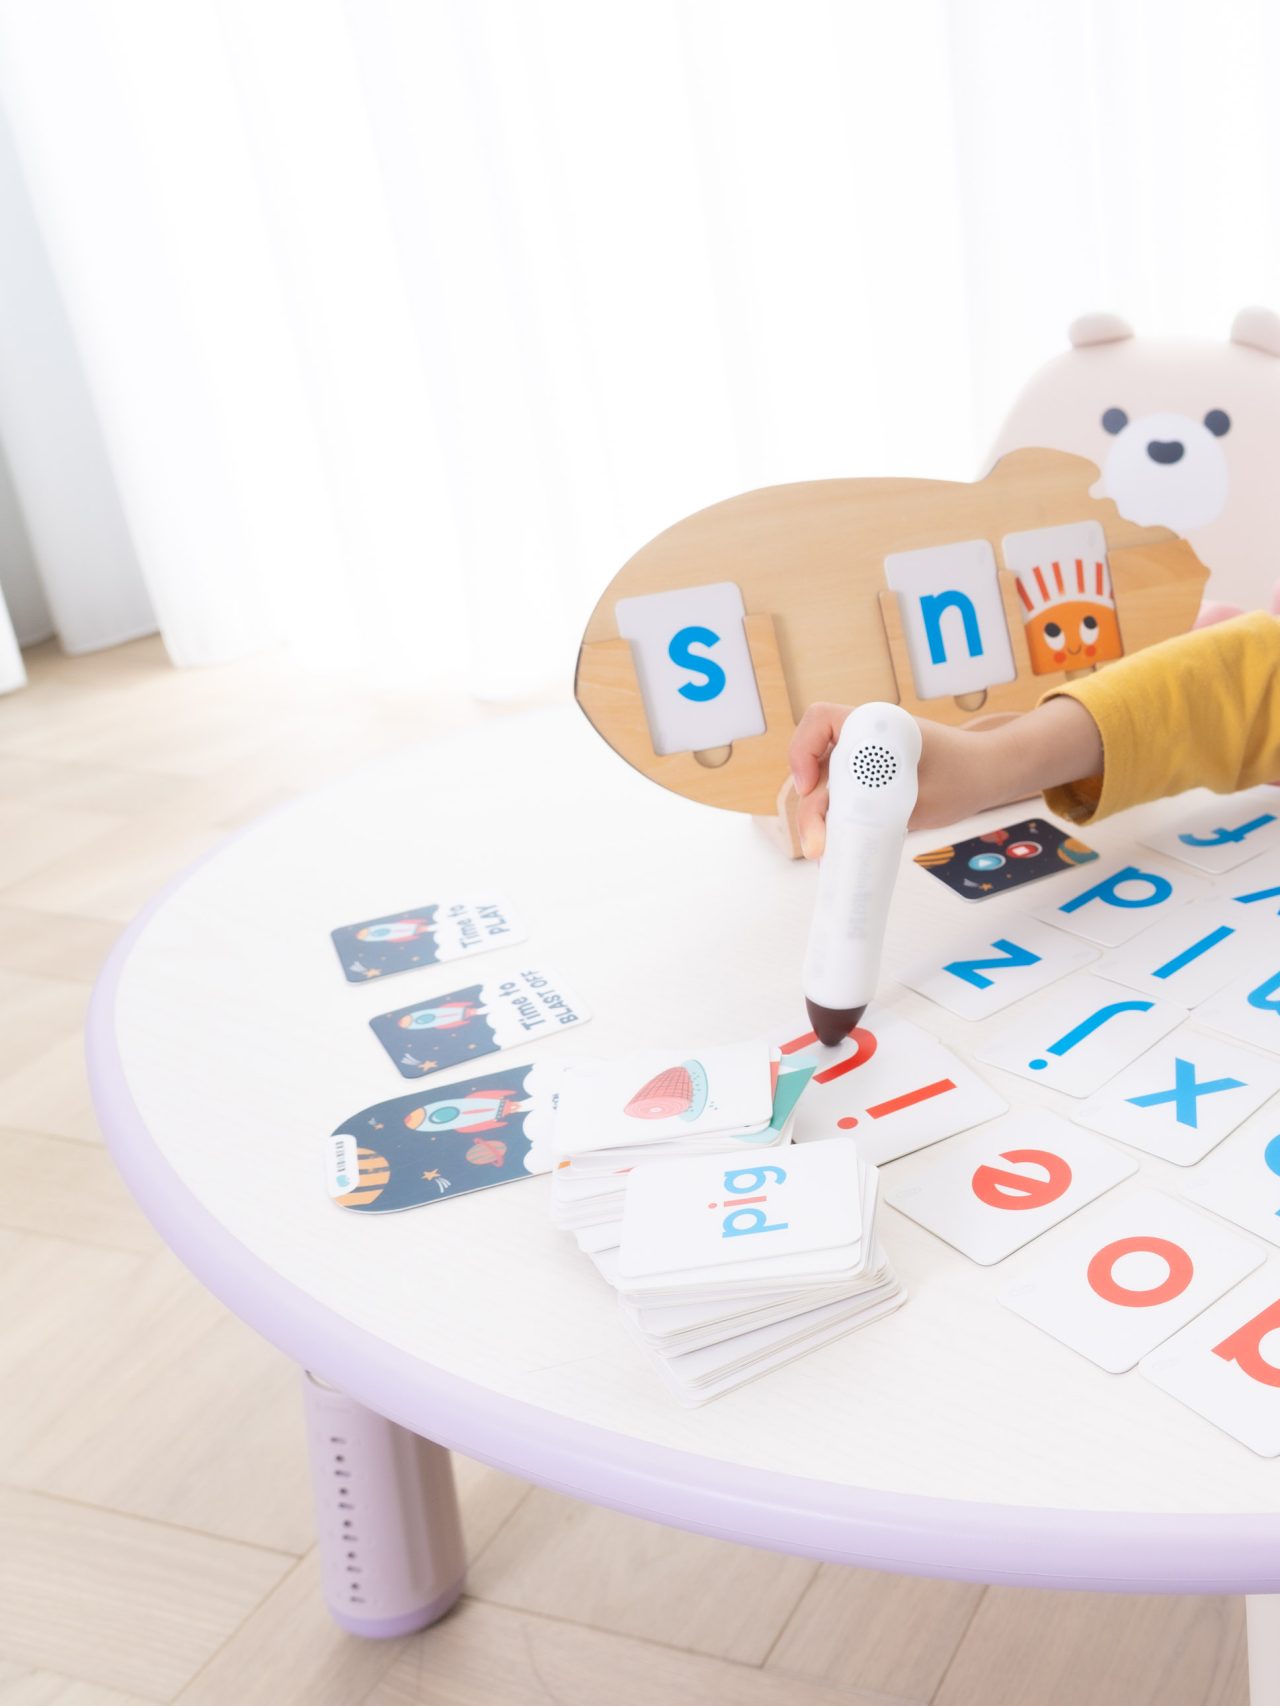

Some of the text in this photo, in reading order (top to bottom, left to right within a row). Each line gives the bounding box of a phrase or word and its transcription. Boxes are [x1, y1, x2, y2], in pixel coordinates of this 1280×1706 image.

[919, 589, 984, 666] n
[667, 625, 727, 703] s
[1179, 814, 1277, 847] f
[448, 904, 483, 948] Time to
[476, 905, 510, 935] PLAY
[943, 938, 1042, 990] z
[499, 982, 546, 1030] Time to
[520, 970, 579, 1025] BLAST OFF
[1028, 1000, 1154, 1071] j
[837, 1078, 957, 1130] i
[1127, 1058, 1245, 1128] x
[708, 1165, 788, 1238] pig
[971, 1149, 1072, 1211] e
[1087, 1236, 1194, 1308] o
